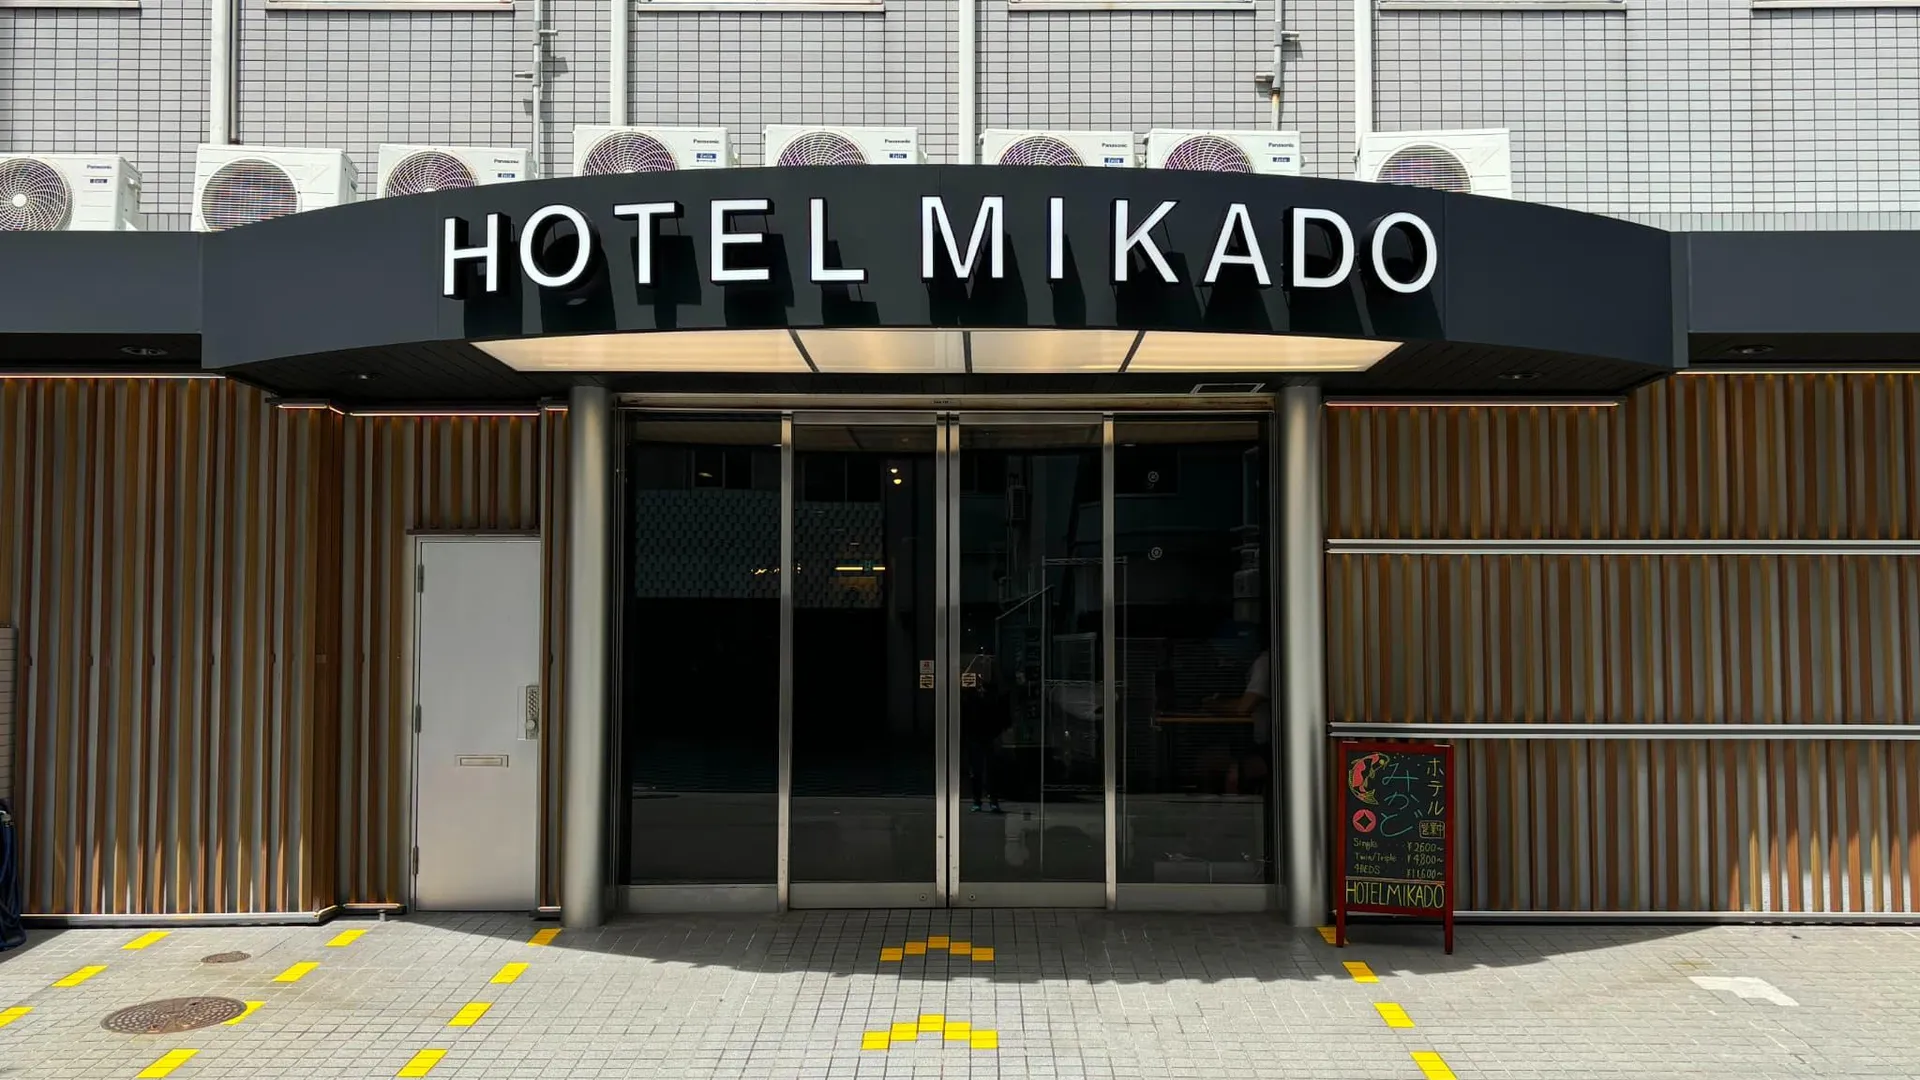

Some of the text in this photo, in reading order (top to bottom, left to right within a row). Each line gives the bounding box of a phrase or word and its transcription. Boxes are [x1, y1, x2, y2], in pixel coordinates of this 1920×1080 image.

[443, 195, 1438, 297] HOTEL MIKADO
[1380, 762, 1423, 837] みかど
[1426, 757, 1445, 816] ホテル
